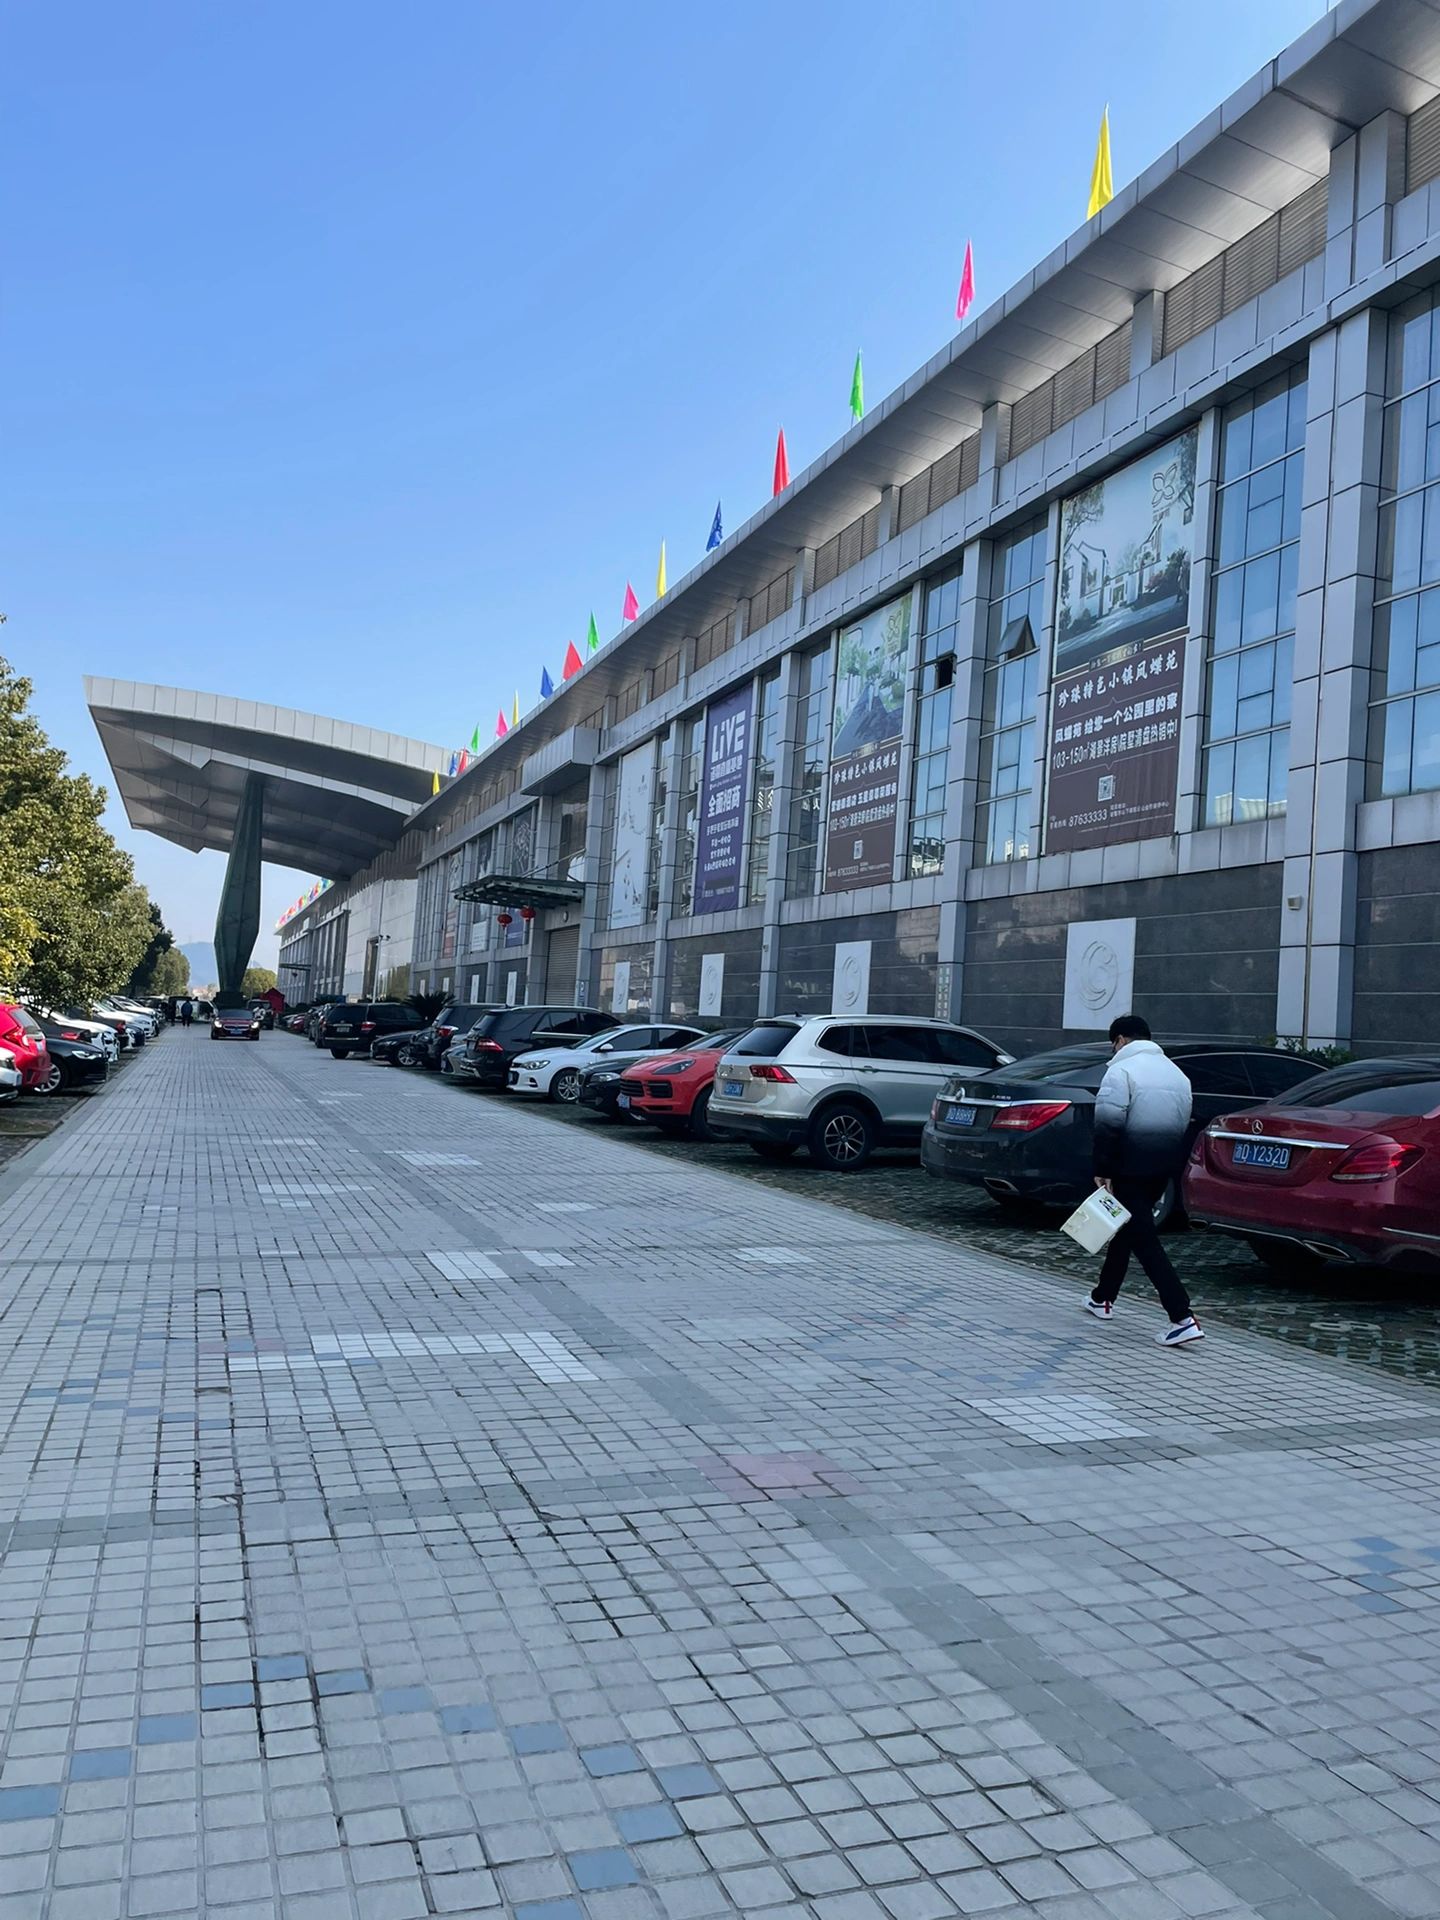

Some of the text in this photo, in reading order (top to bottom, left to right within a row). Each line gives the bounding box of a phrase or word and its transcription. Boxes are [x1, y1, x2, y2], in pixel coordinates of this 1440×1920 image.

[708, 785, 741, 818] 全面招商
[1068, 808, 1107, 827] 87633333
